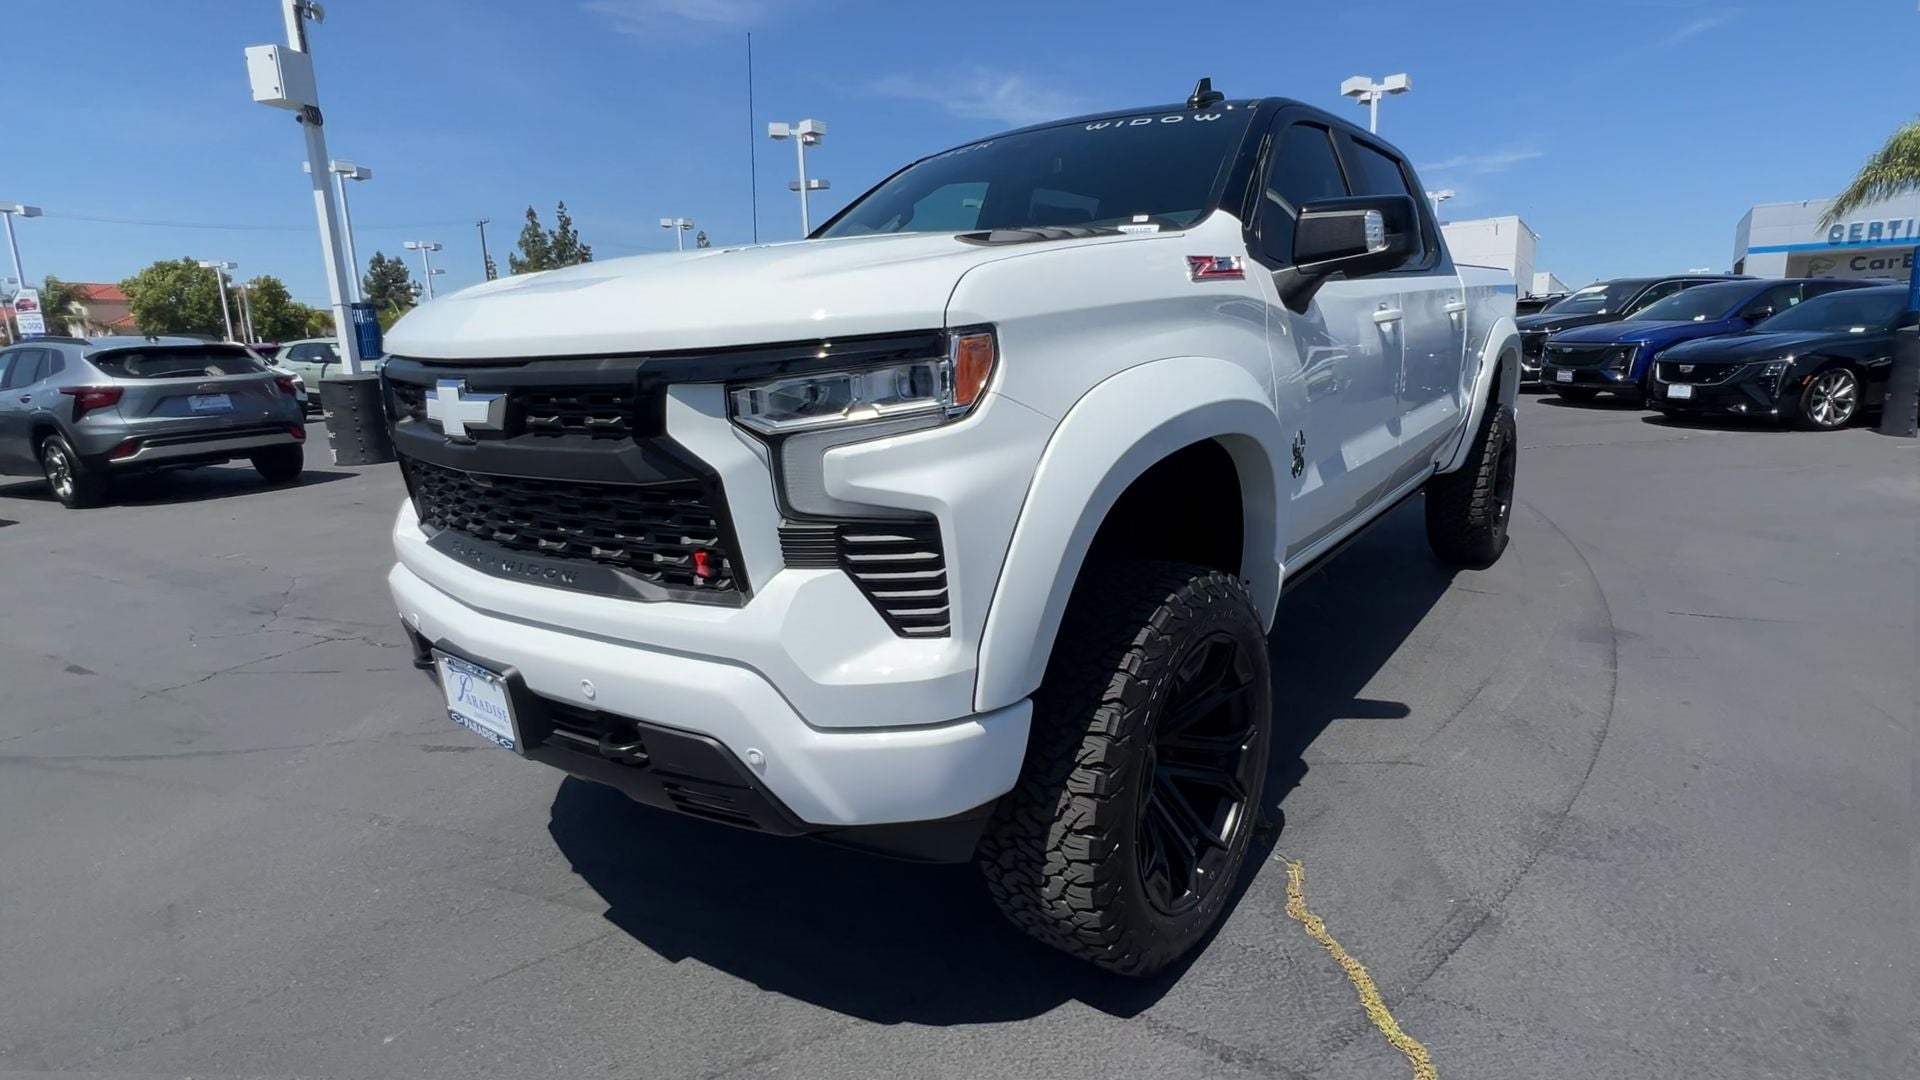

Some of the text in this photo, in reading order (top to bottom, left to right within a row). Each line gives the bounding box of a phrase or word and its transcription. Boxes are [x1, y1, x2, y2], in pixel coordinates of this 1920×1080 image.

[1085, 113, 1221, 130] WIDOW
[1828, 217, 1920, 244] CERTI
[501, 559, 578, 583] WIDOW
[458, 673, 509, 723] PARADISE
